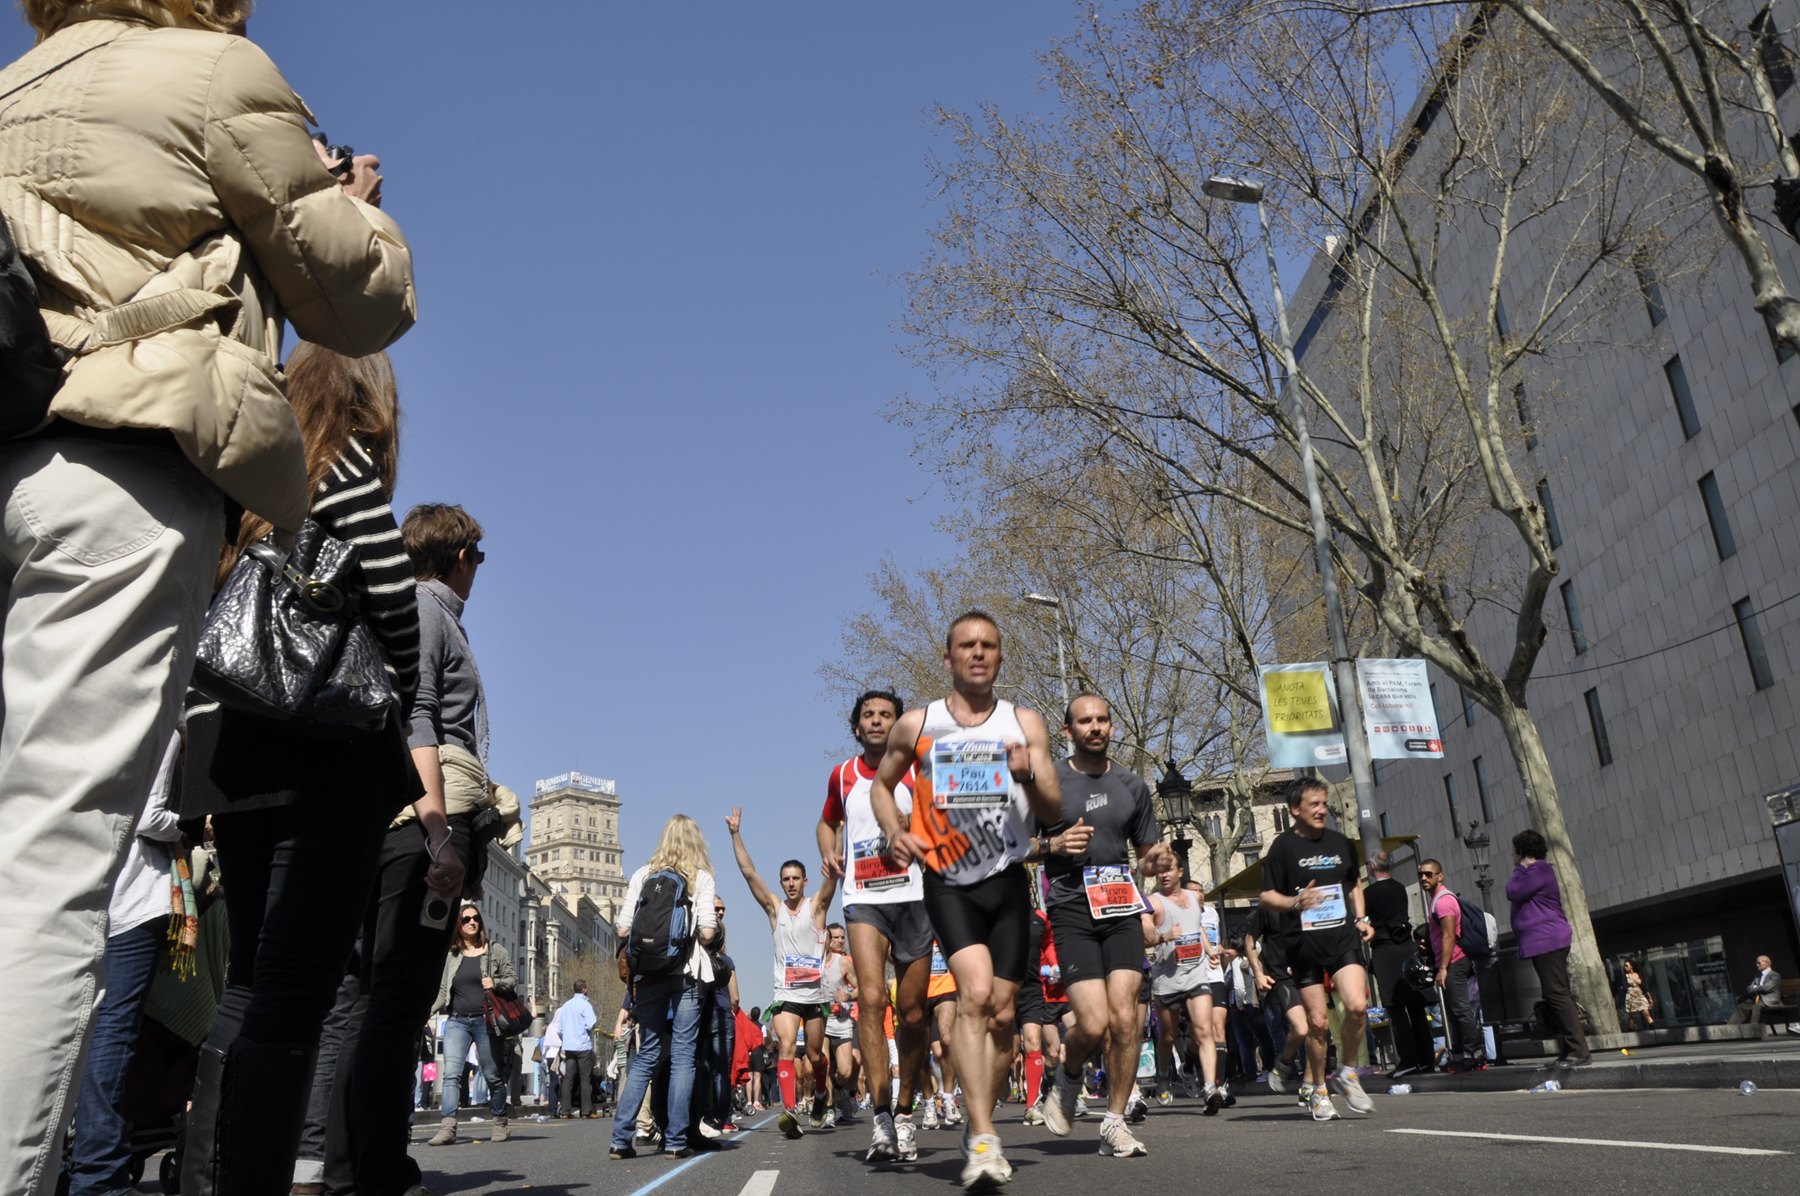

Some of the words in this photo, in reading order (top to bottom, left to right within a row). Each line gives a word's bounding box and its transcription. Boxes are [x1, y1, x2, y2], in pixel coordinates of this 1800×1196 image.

[1277, 682, 1305, 692] ANOTA
[1274, 698, 1288, 707] LES
[1291, 696, 1318, 705] TEVES
[1275, 710, 1324, 722] PRIORITATS
[961, 768, 986, 779] Pau
[960, 781, 988, 791] 7614
[1086, 793, 1108, 812] RUN
[1103, 886, 1127, 895] Bruno
